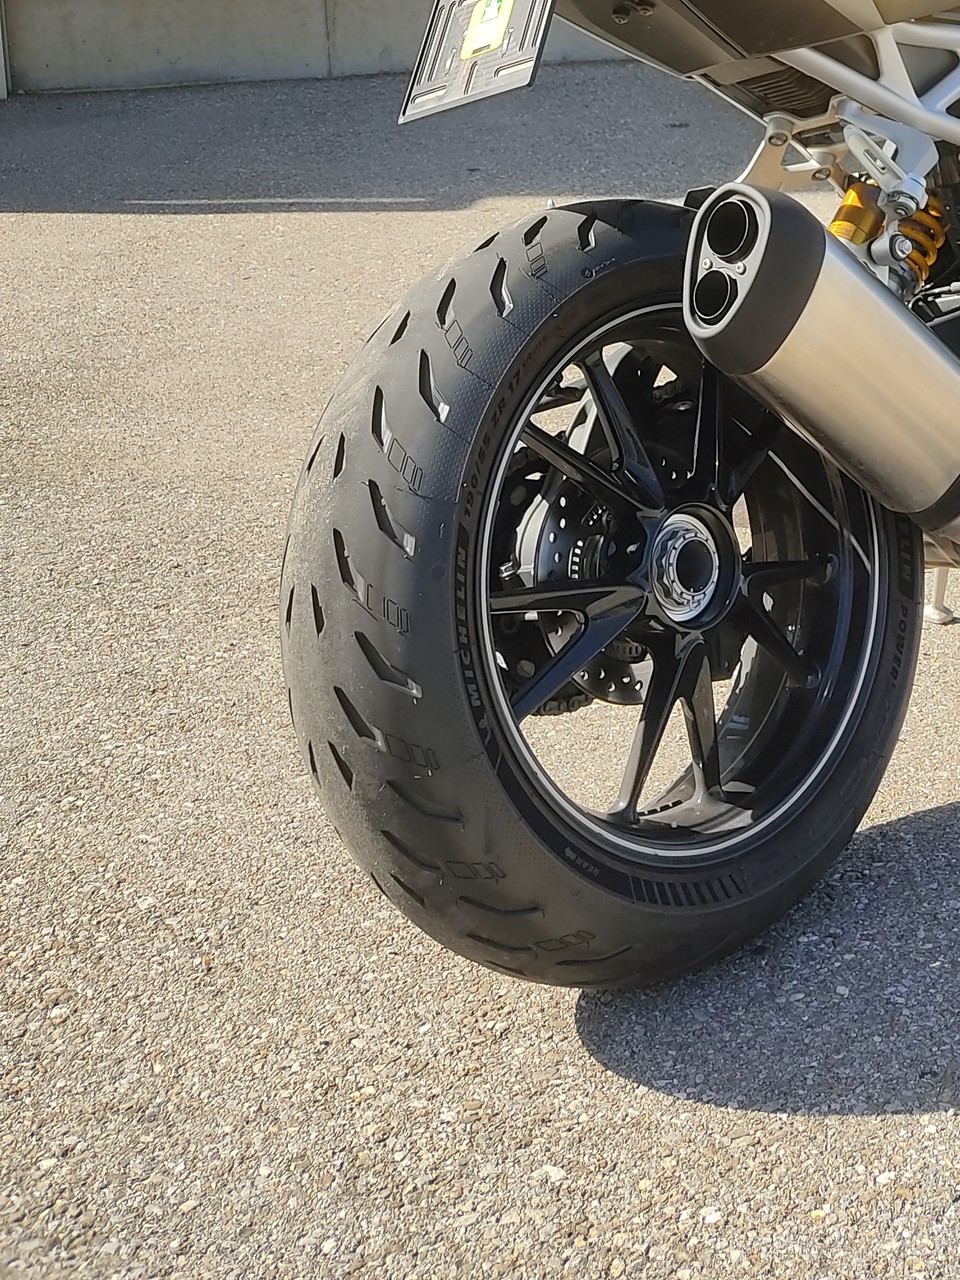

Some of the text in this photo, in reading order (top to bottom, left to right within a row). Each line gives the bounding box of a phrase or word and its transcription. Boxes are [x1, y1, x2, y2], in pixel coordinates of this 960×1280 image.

[464, 369, 521, 518] 190/55 ZR 17
[456, 546, 482, 708] MICHELIN
[890, 604, 909, 678] POWER
[575, 855, 601, 876] REAR
